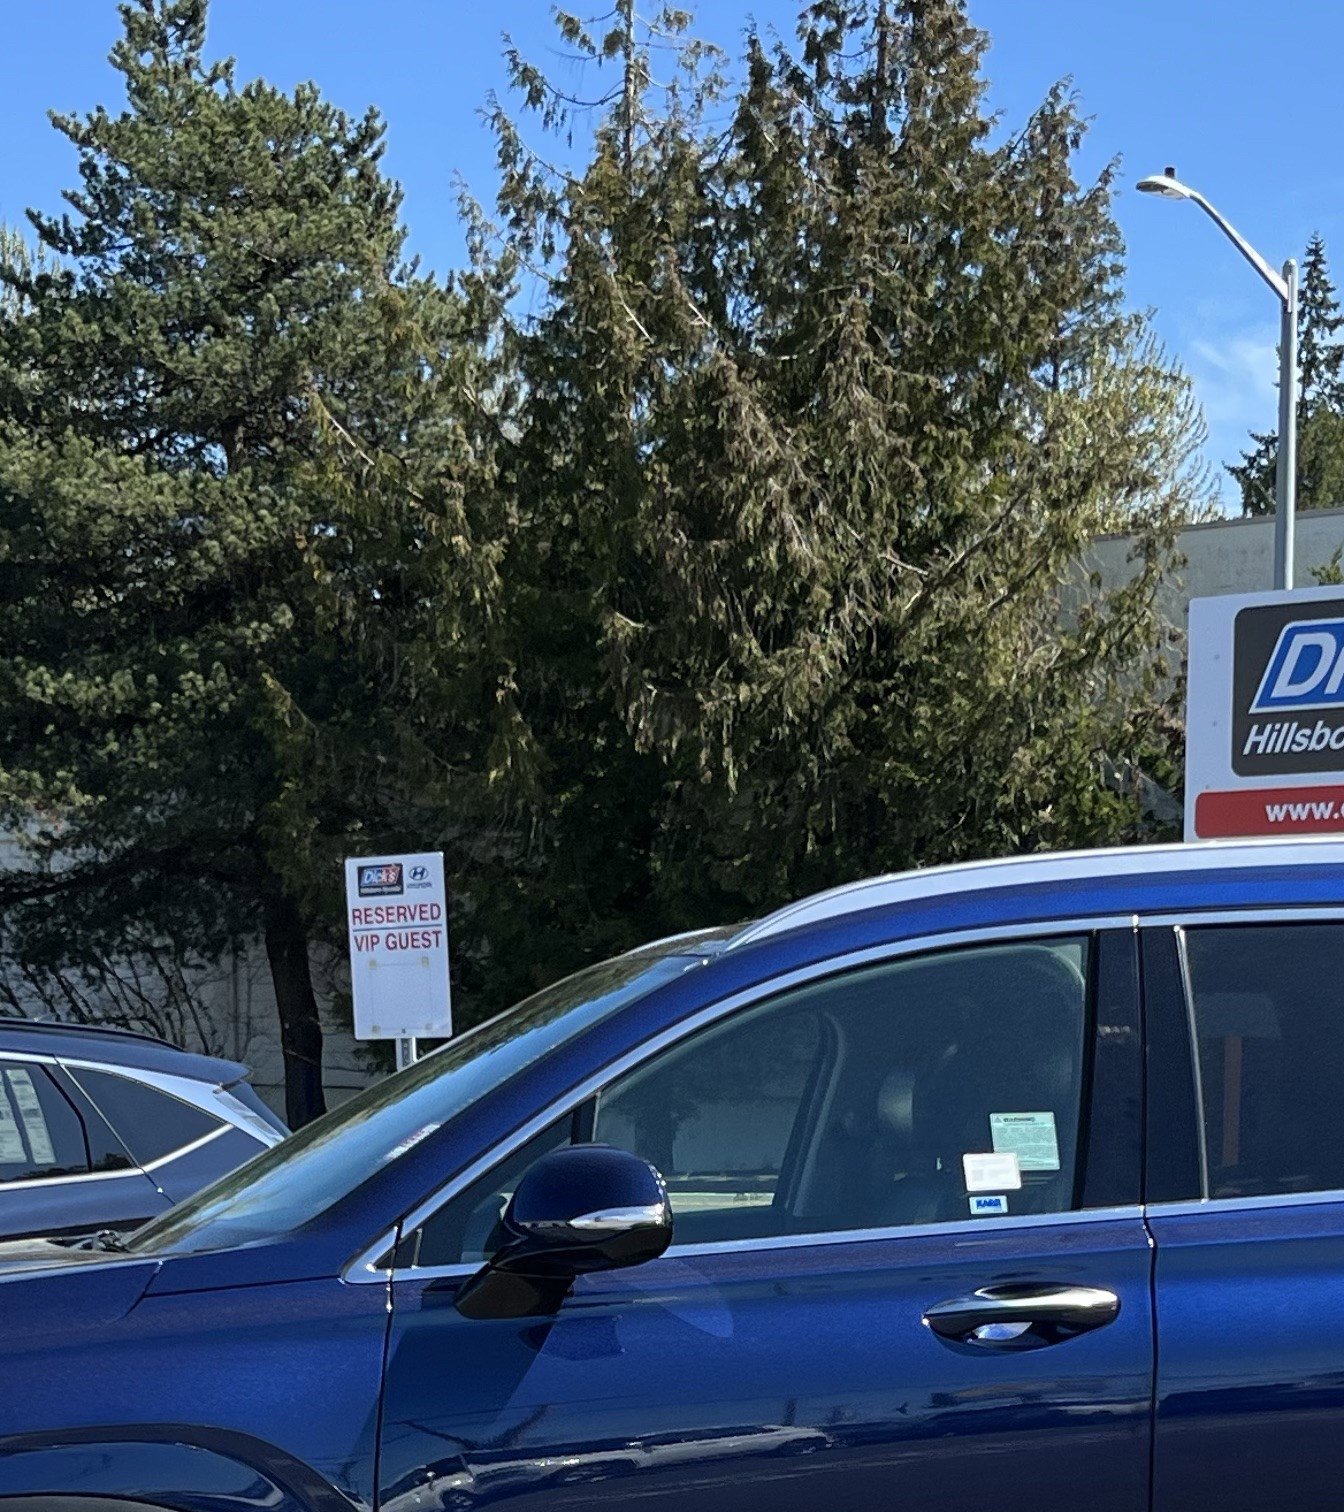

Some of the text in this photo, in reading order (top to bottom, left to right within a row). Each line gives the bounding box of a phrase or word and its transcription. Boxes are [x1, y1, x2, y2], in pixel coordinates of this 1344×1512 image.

[351, 902, 441, 926] RESERVED
[354, 930, 442, 952] VIP GUEST
